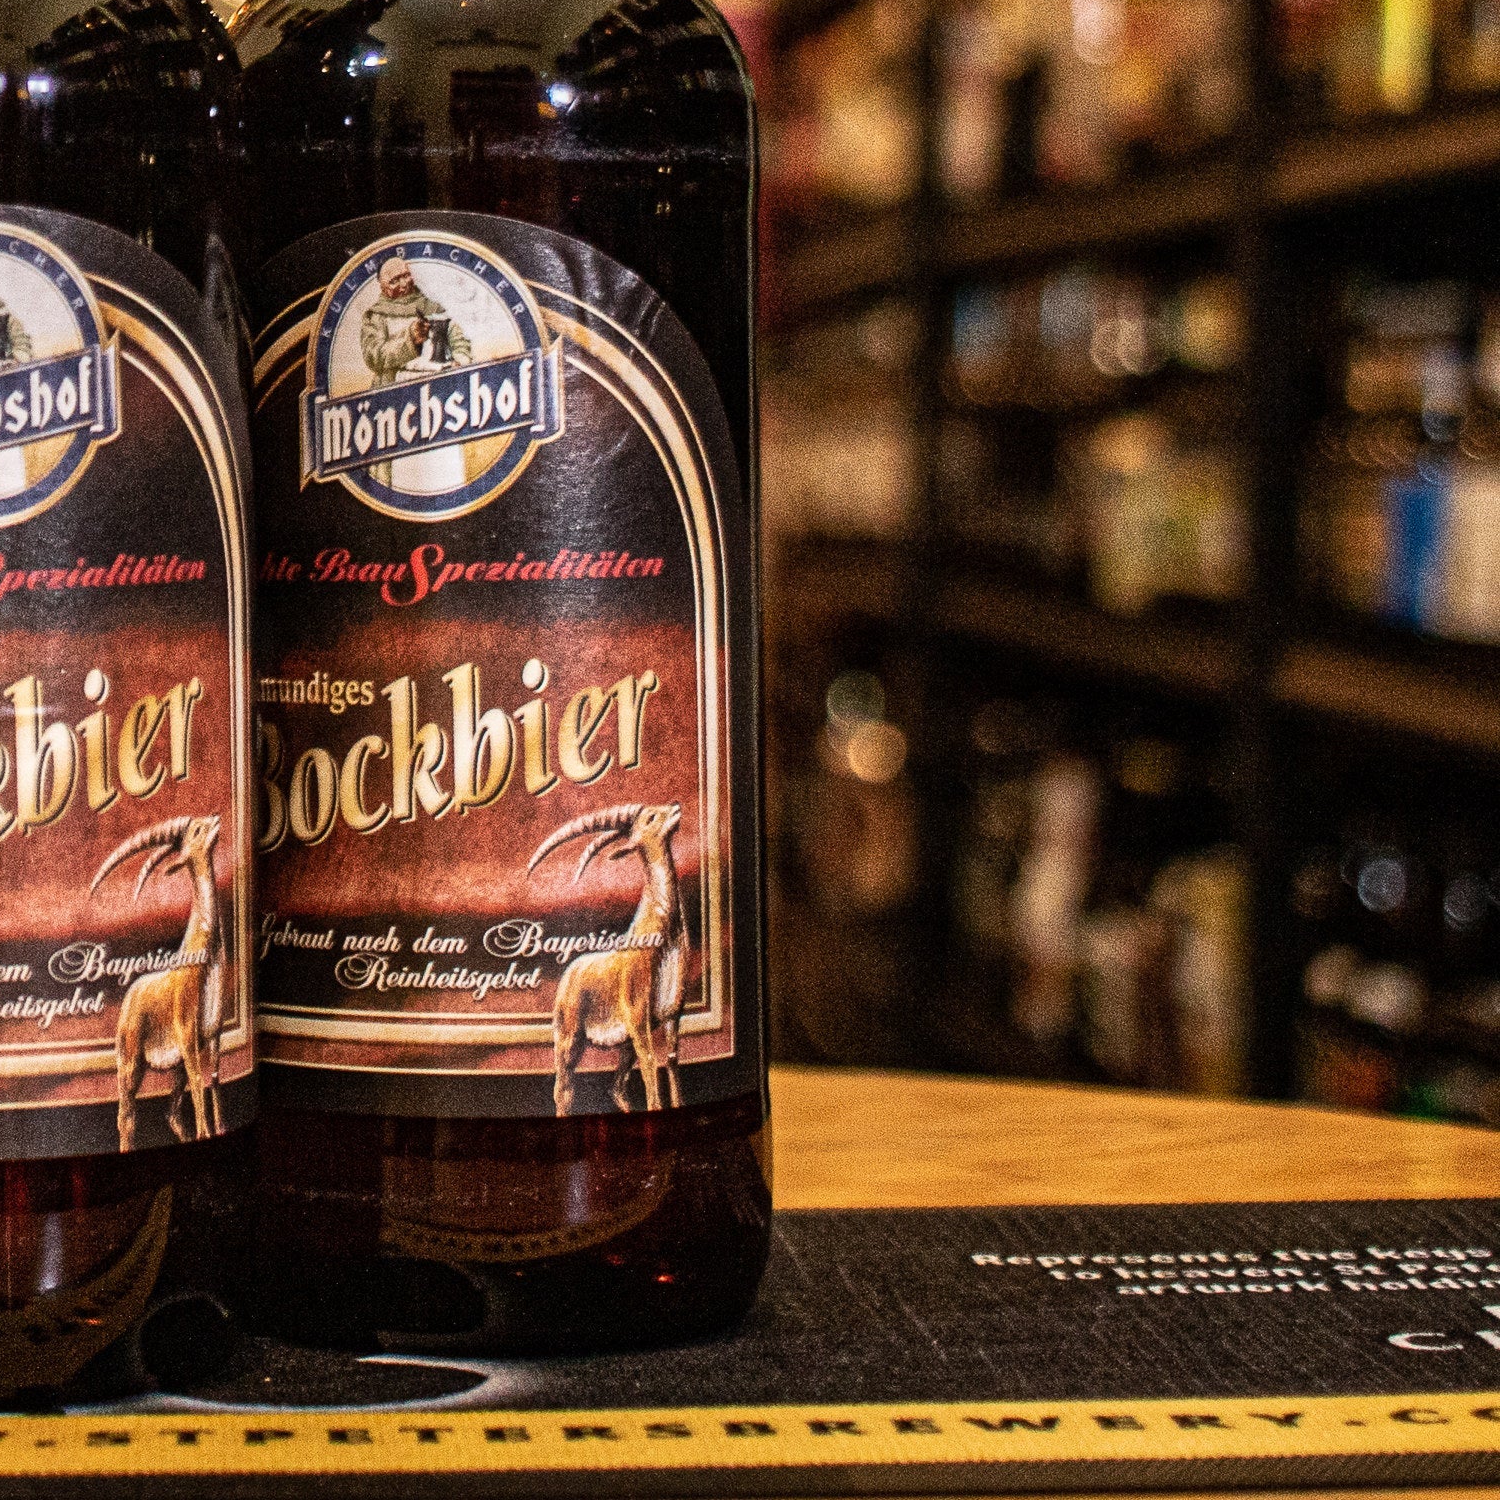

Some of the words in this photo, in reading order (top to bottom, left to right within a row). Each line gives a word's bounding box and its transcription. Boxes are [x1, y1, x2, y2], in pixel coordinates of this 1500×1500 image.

[320, 244, 524, 339] KULMBACHER
[322, 359, 534, 464] Mönchshof
[260, 551, 302, 583] hte
[260, 670, 375, 715] mundiges
[343, 925, 402, 955] nach
[412, 926, 468, 954] dem
[482, 918, 665, 964] Bayerischen
[48, 941, 210, 994] Bayerischen
[334, 954, 542, 999] Reinheitsgebot
[971, 1251, 1261, 1268] Represents
[1272, 1248, 1357, 1262] the
[1366, 1246, 1492, 1261] keys
[1048, 1268, 1102, 1281] to
[1111, 1265, 1323, 1281] heaven.
[1332, 1263, 1388, 1277] St
[1115, 1280, 1331, 1296] artwork
[1341, 1277, 1500, 1293] holdin
